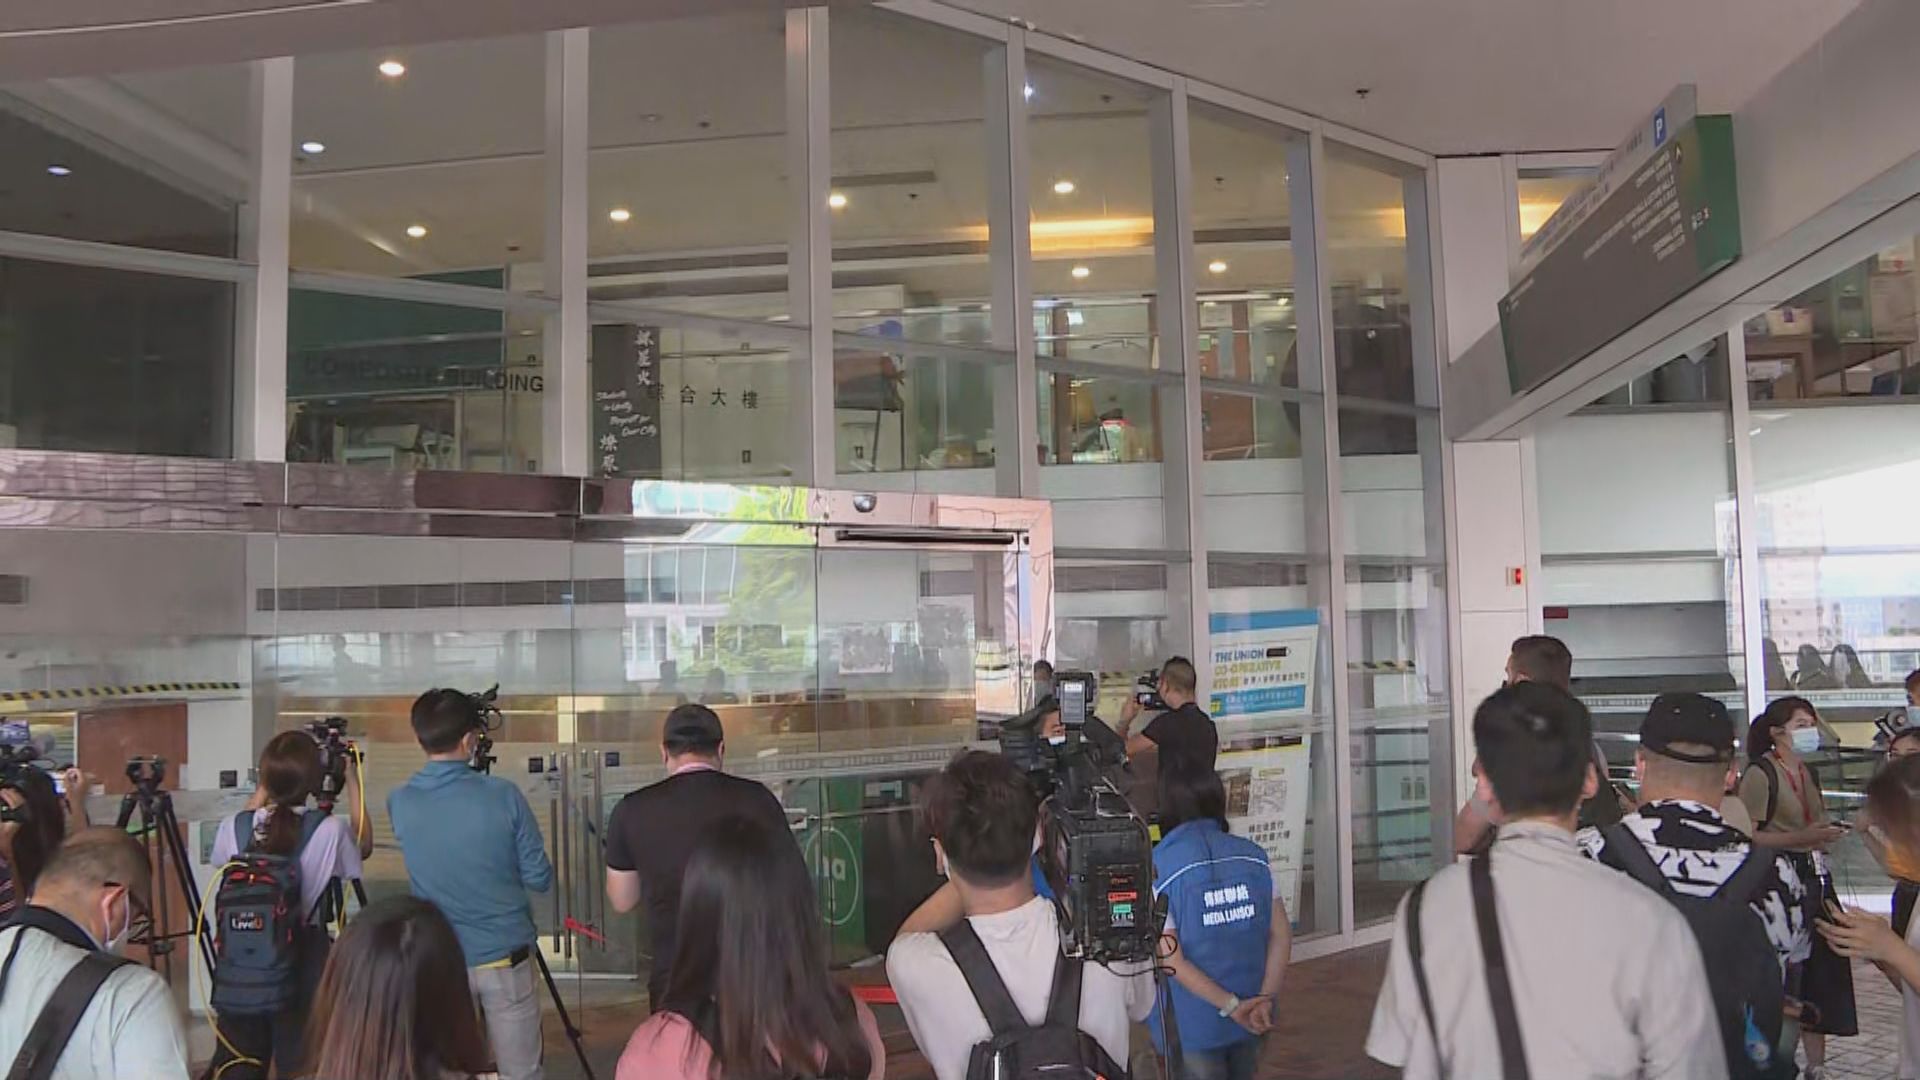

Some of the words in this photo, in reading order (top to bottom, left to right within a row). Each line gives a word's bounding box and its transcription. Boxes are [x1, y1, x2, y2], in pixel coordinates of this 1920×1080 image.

[1656, 117, 1664, 139] P
[1215, 651, 1232, 663] THE
[1234, 648, 1265, 661] UNION
